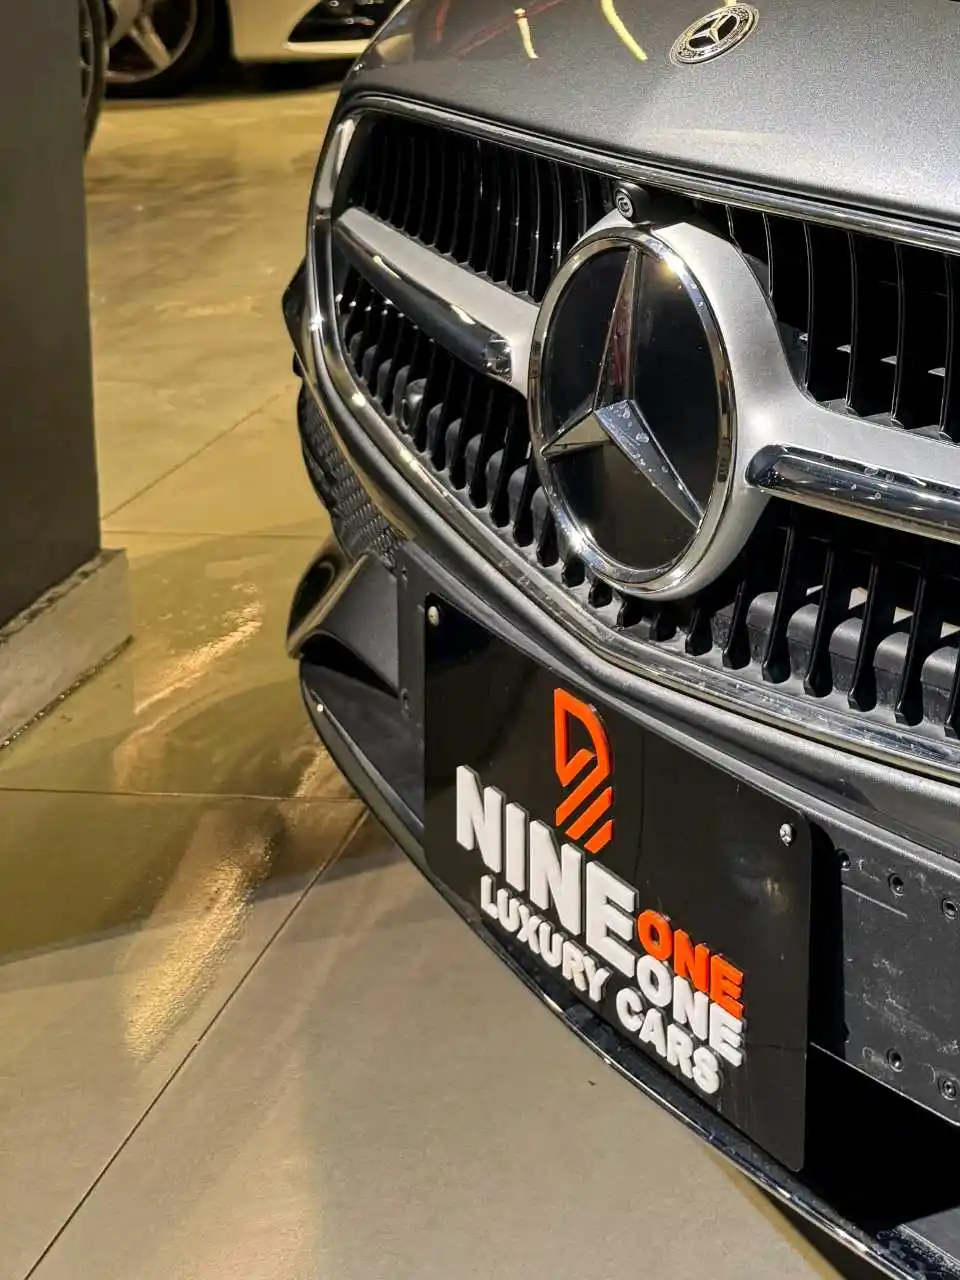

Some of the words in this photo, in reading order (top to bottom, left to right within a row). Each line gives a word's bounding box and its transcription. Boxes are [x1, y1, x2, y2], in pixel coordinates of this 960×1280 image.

[456, 765, 641, 978] NINE
[480, 874, 613, 1002] LUXURY
[616, 987, 721, 1094] CARS
[636, 954, 744, 1067] ONE
[637, 908, 745, 1021] ONE
